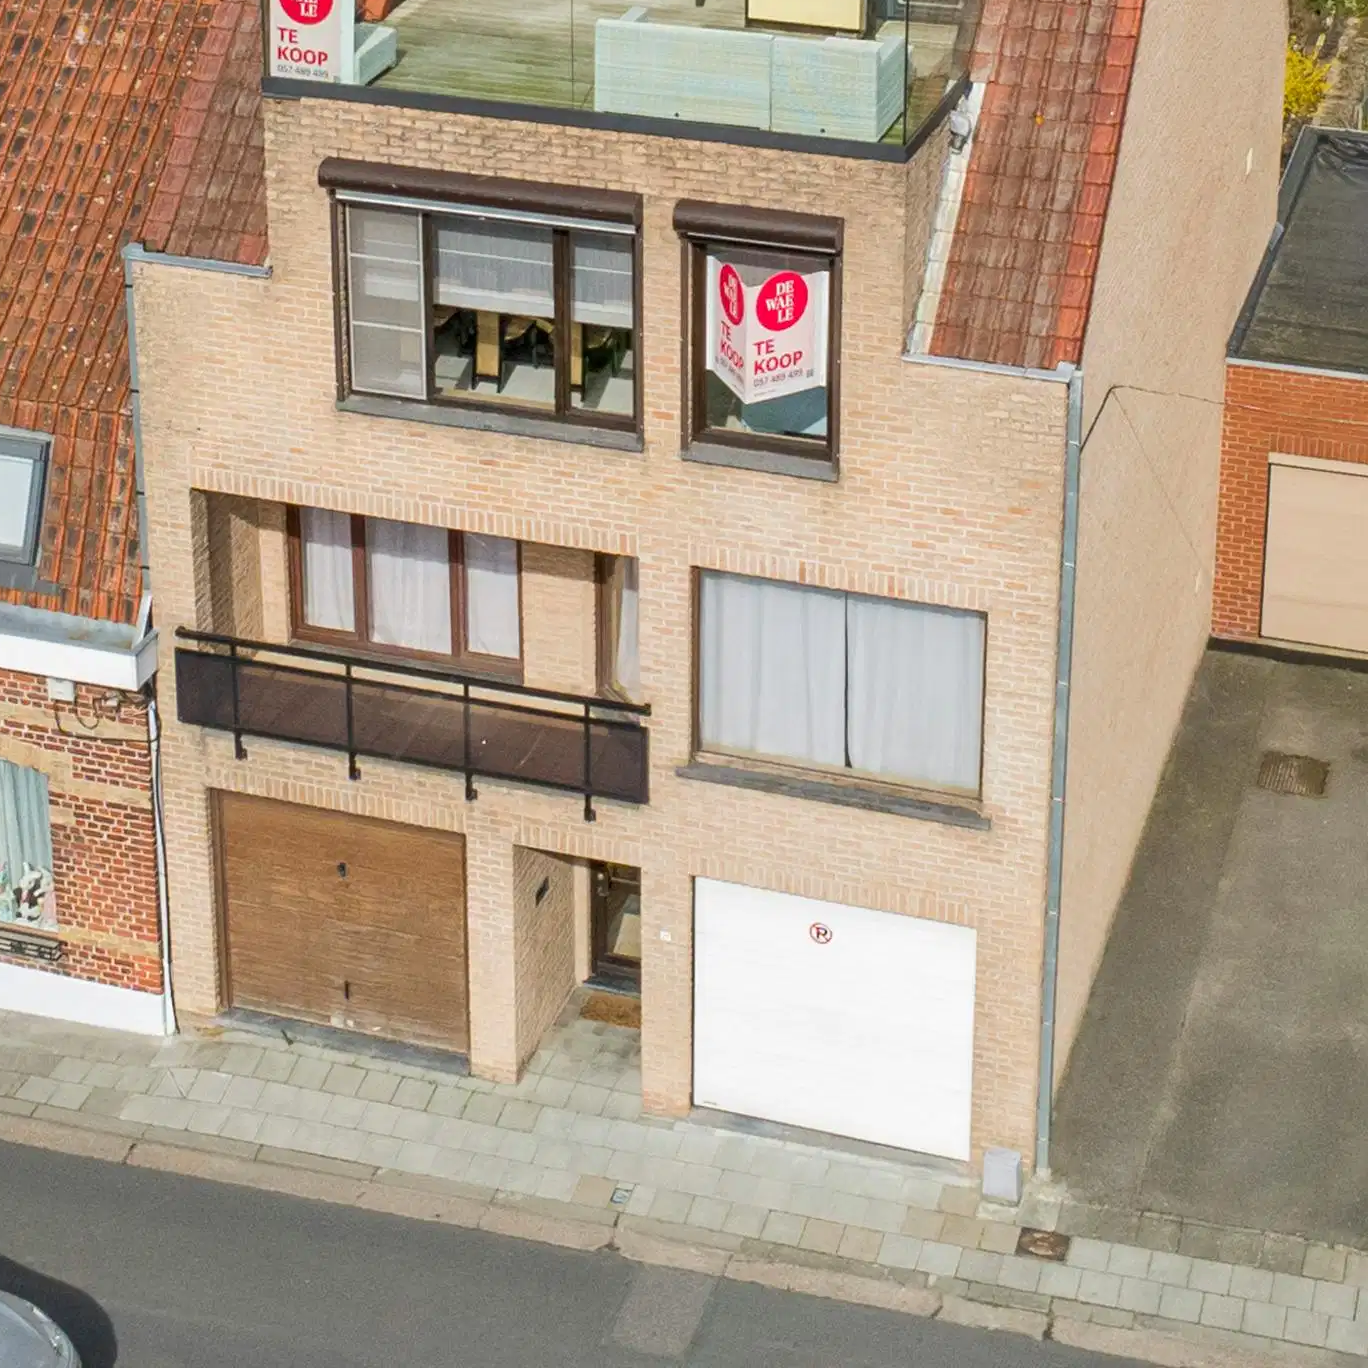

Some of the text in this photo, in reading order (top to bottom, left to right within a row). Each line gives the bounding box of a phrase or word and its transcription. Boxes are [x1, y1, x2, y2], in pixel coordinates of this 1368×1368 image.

[299, 3, 318, 18] LE
[277, 26, 299, 44] TE
[277, 46, 329, 67] KOOP
[776, 279, 794, 295] DE
[766, 294, 794, 311] WAE
[777, 307, 794, 324] LE
[720, 320, 732, 342] TE
[720, 339, 744, 369] KOOP
[753, 339, 775, 356] TE
[753, 350, 803, 375] KOOP
